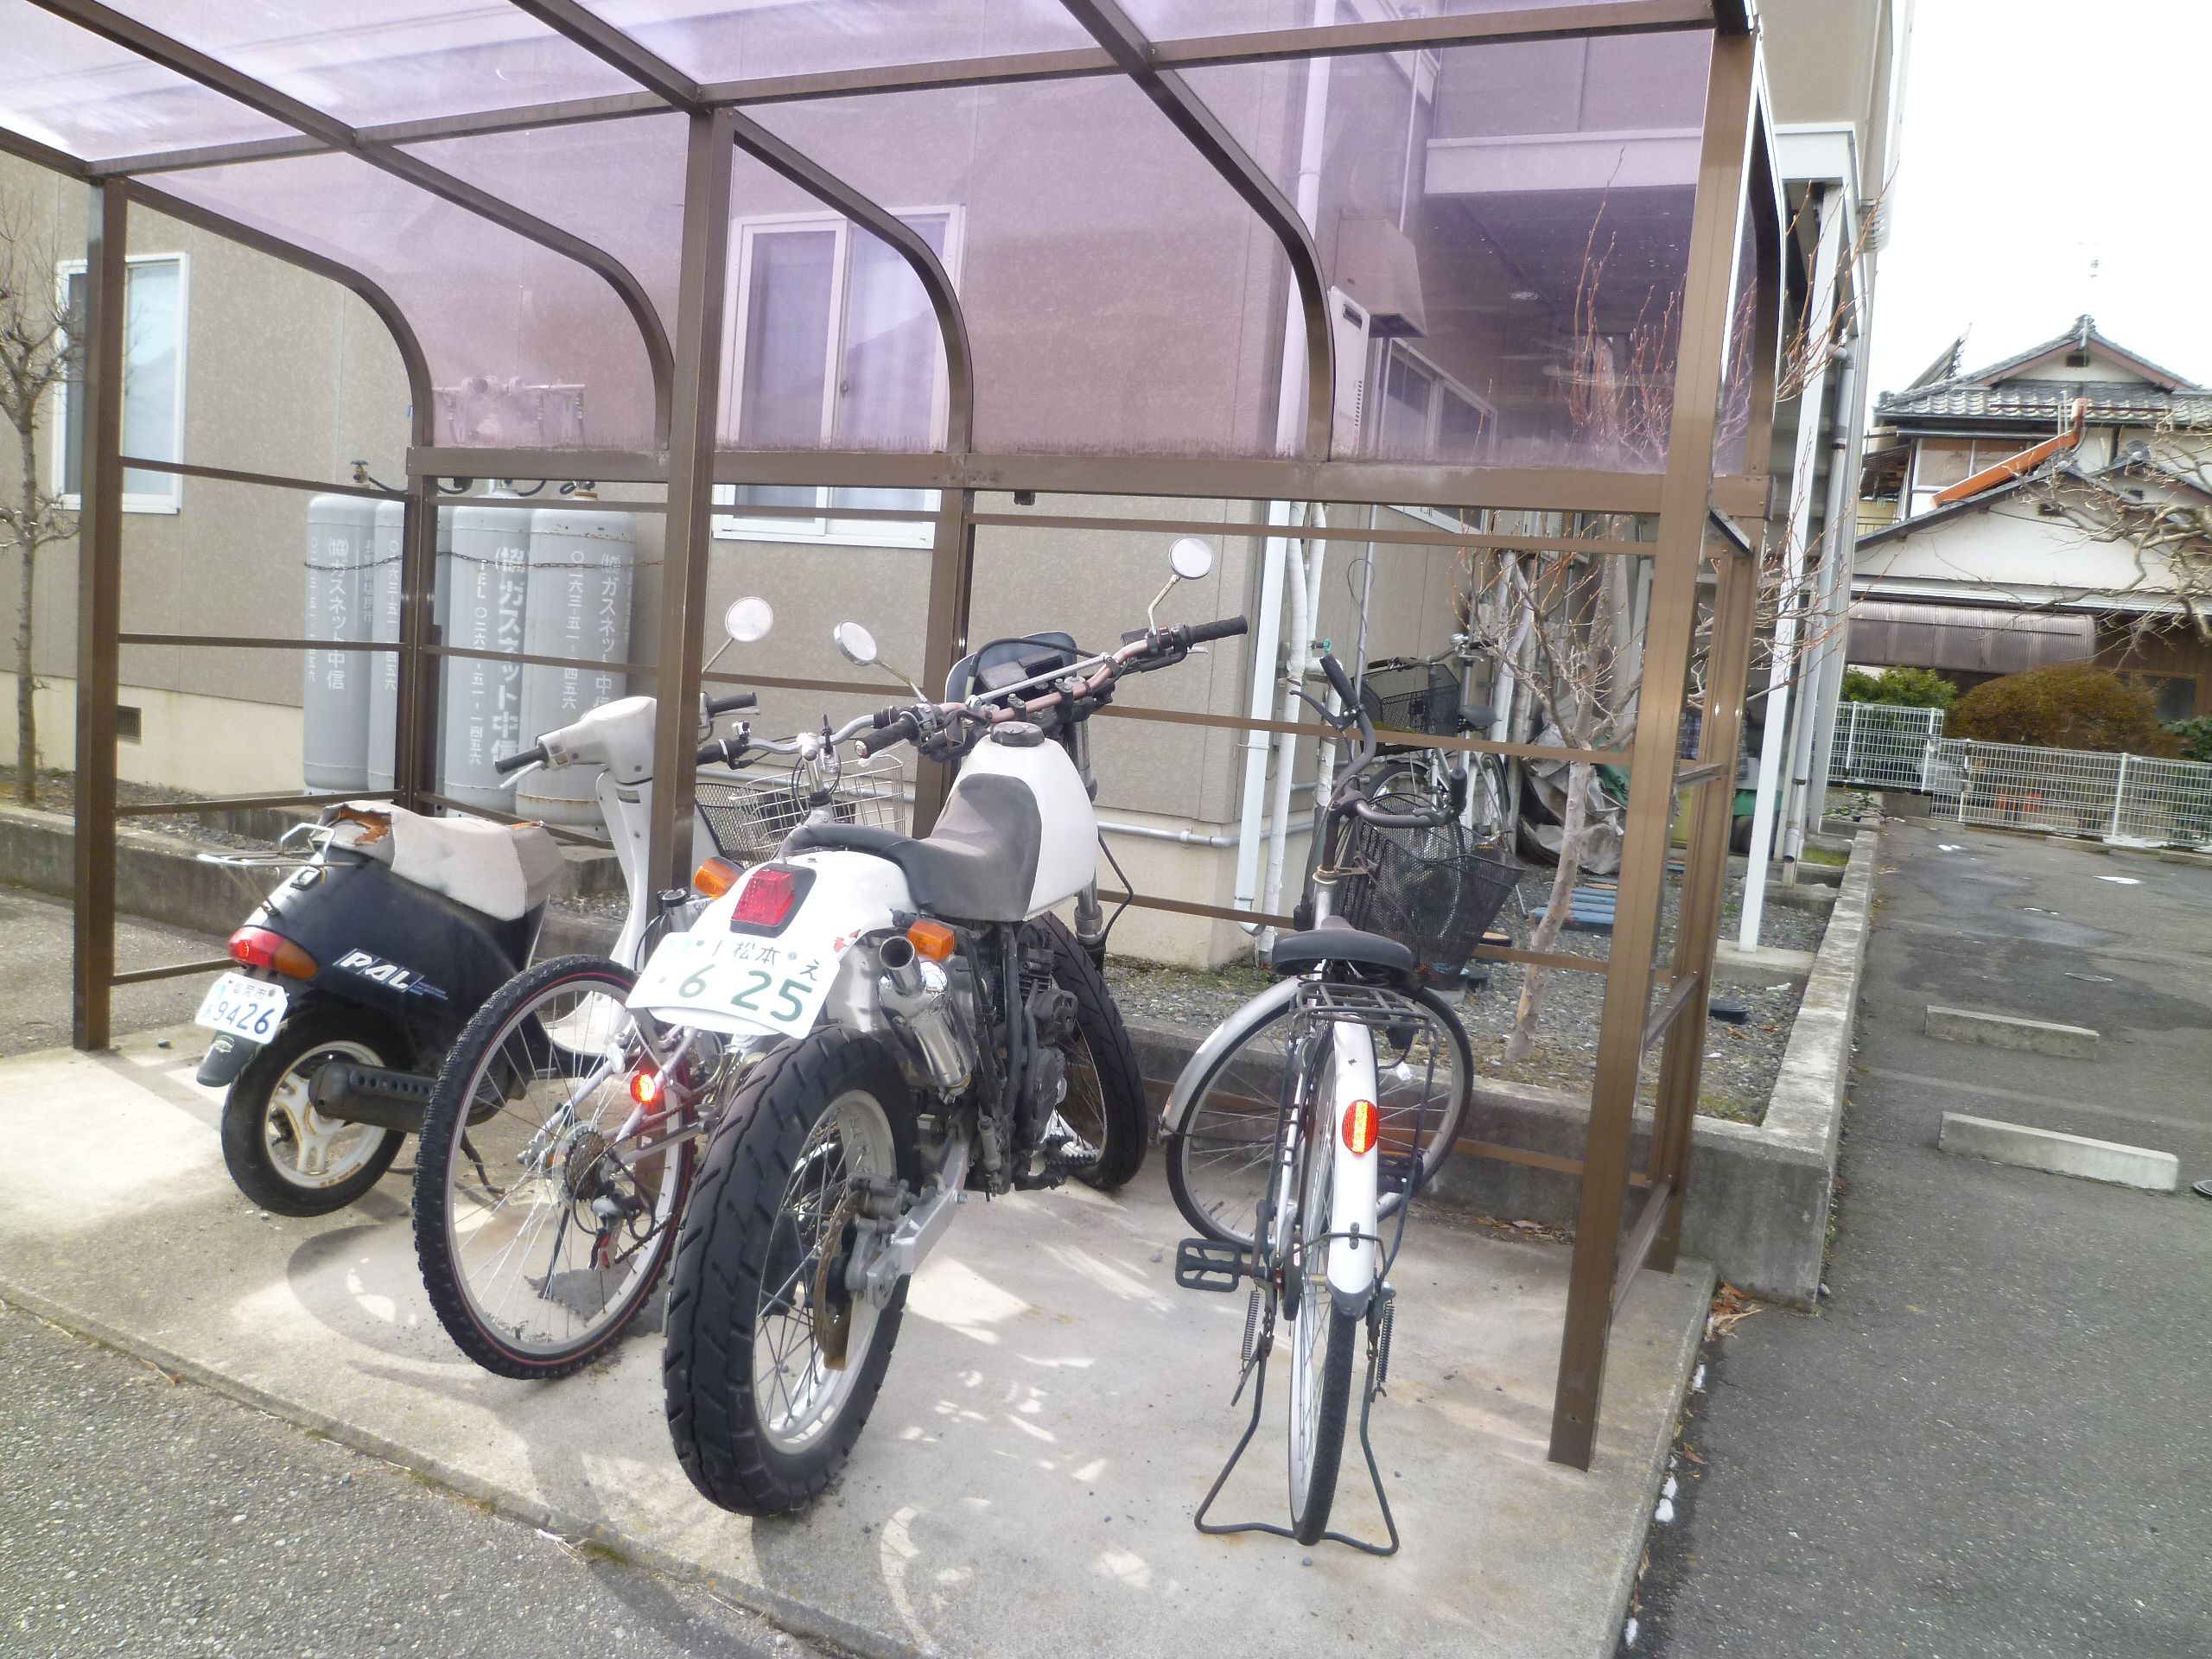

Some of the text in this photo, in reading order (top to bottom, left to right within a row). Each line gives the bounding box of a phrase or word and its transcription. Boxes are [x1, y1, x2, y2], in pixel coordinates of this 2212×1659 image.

[340, 951, 410, 989] PAL
[799, 959, 820, 982] え
[213, 1001, 276, 1035] 9426
